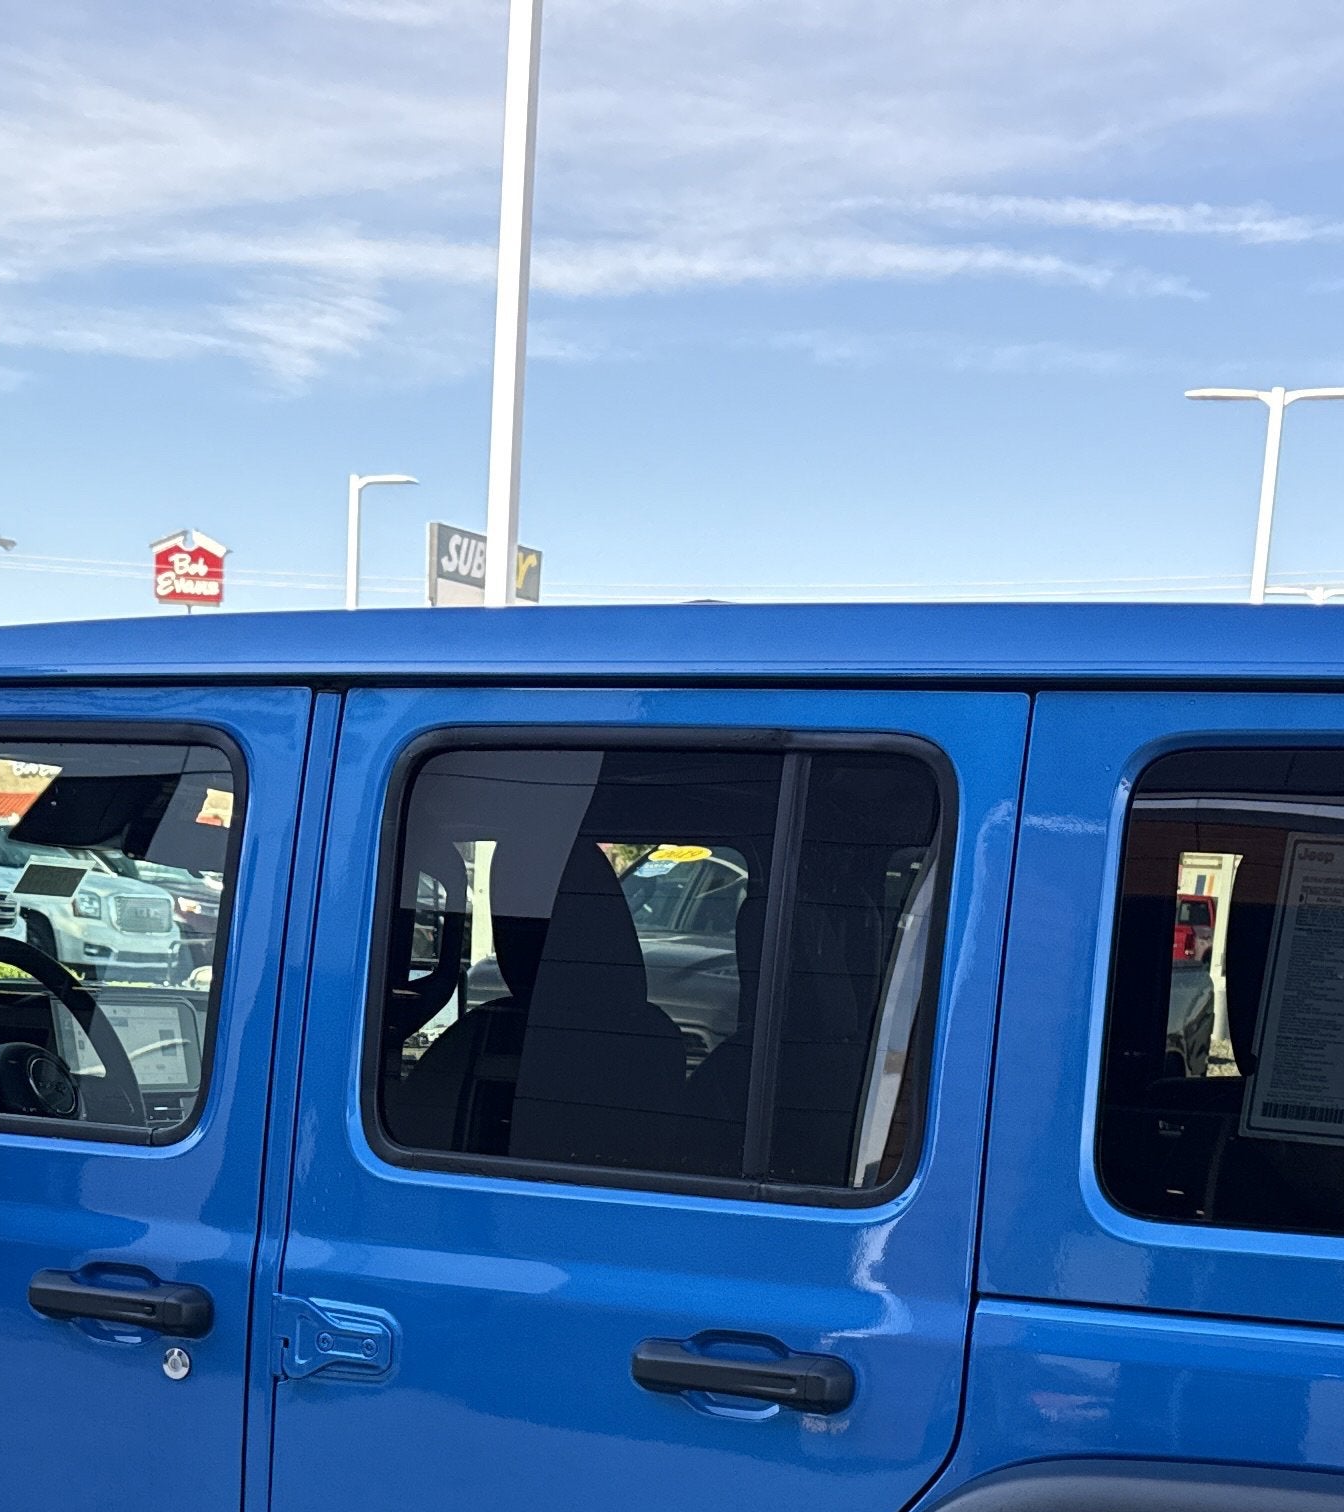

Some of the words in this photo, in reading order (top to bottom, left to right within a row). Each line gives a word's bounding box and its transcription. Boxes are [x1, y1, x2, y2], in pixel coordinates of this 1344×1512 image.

[168, 553, 208, 577] Bob
[441, 534, 537, 589] SUBY
[156, 571, 220, 596] Evans
[1298, 848, 1335, 864] Jeep
